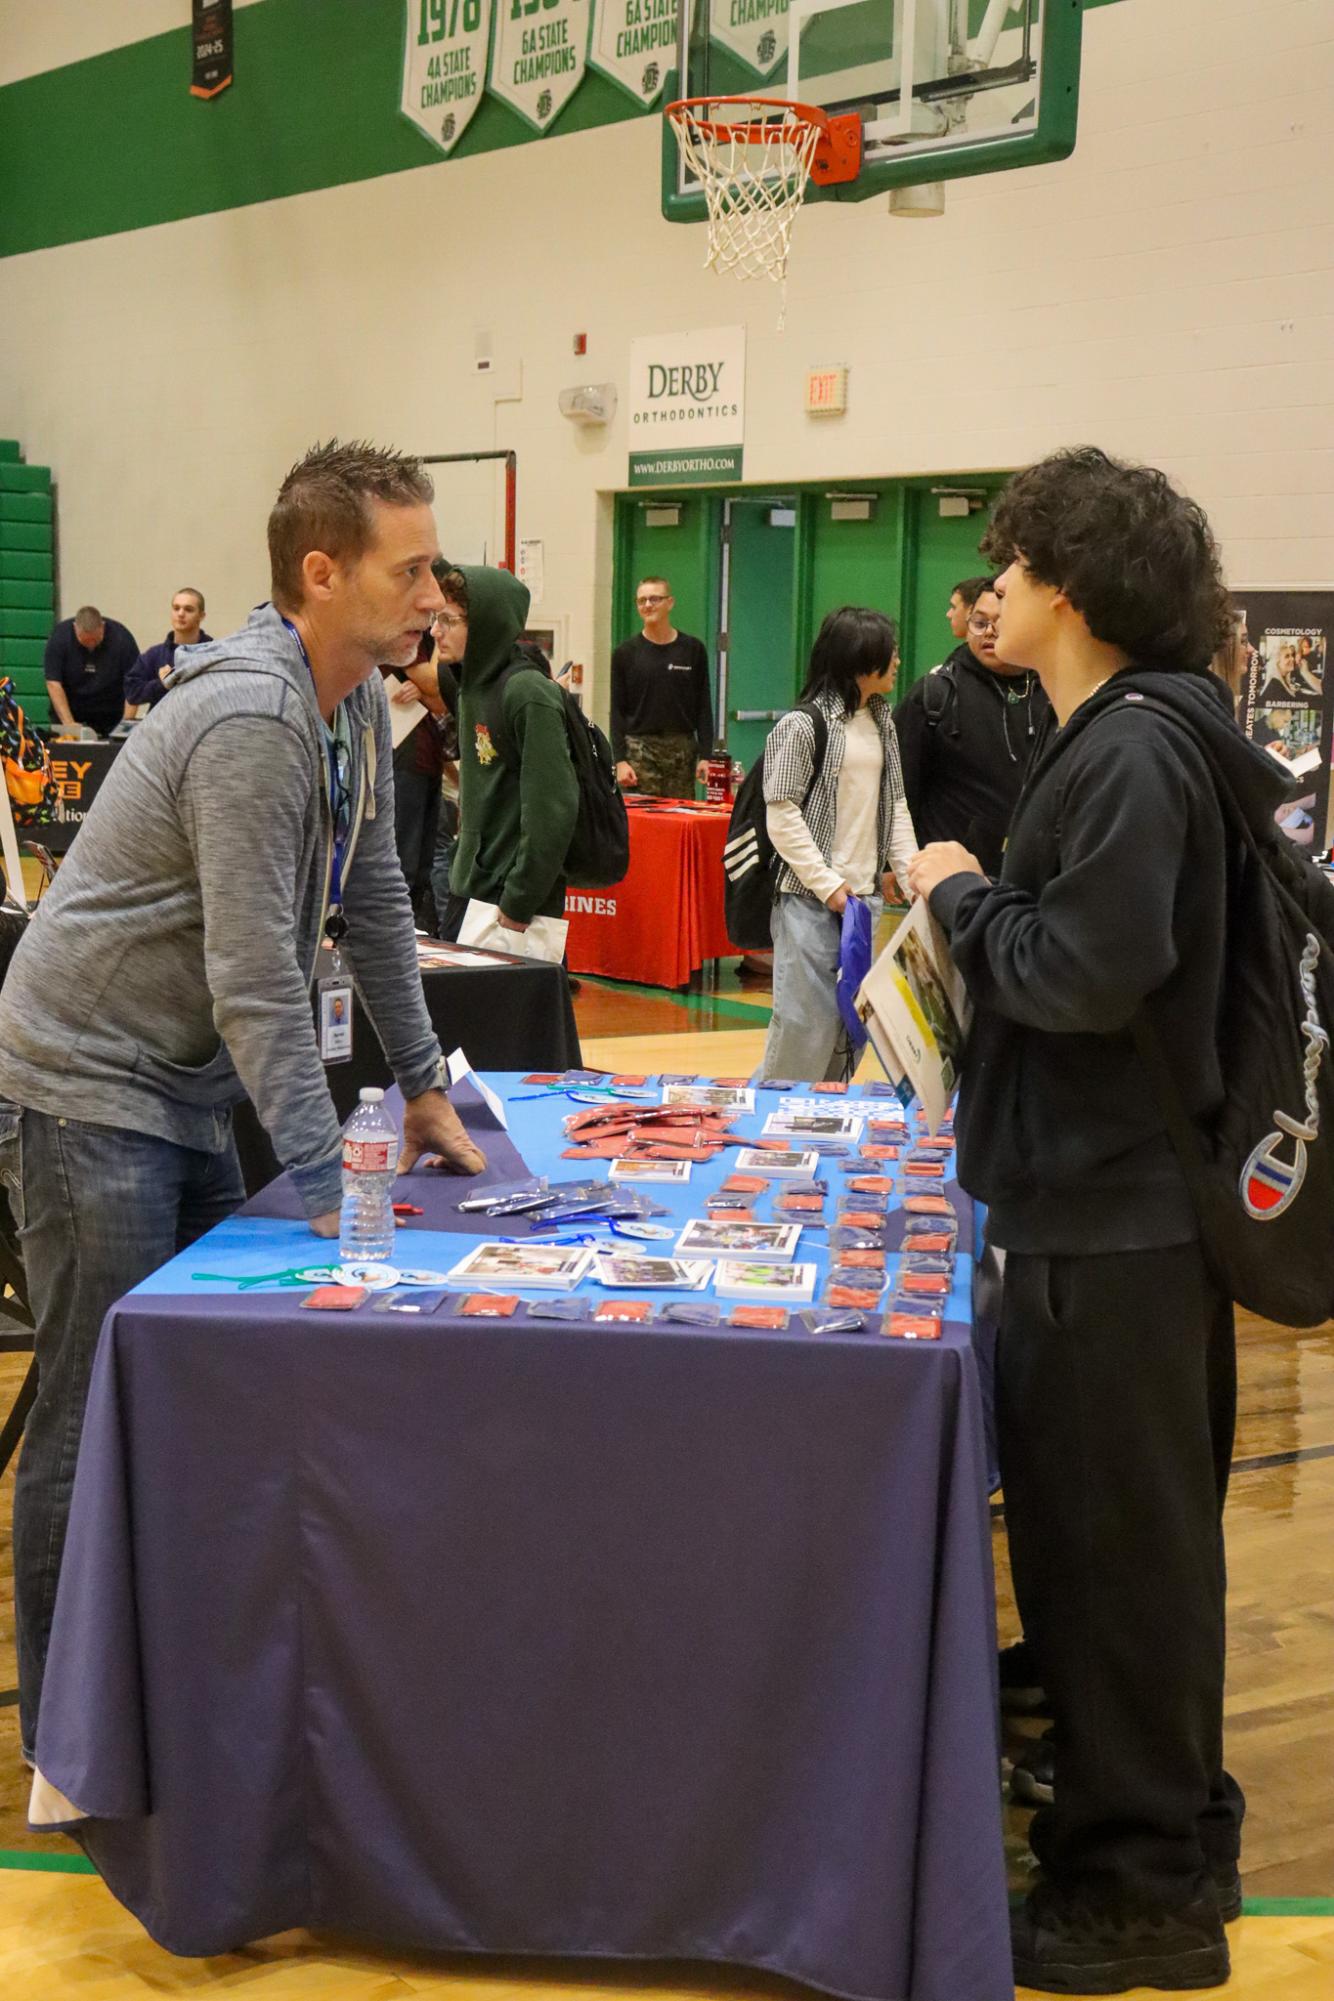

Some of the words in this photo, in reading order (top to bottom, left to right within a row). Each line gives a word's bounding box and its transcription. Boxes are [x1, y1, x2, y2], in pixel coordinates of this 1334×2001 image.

[730, 0, 789, 27] CHAMPIO
[522, 28, 536, 55] 6A
[539, 18, 568, 49] STATE
[616, 17, 678, 58] CHAMPION
[427, 57, 441, 80] 4A
[443, 47, 471, 76] STATE
[513, 46, 576, 85] CHAMPIONS
[421, 72, 476, 109] CHAMPIONS
[647, 361, 724, 401] DERBY
[810, 374, 837, 405] EXIT
[633, 404, 738, 424] ORTHODONTICS
[1264, 628, 1323, 636] COSMETOLOGY
[1247, 650, 1260, 706] TOMORROW
[1265, 700, 1309, 709] BARBERING
[1245, 707, 1255, 740] EATES
[51, 761, 92, 779] EY
[564, 895, 616, 916] INES
